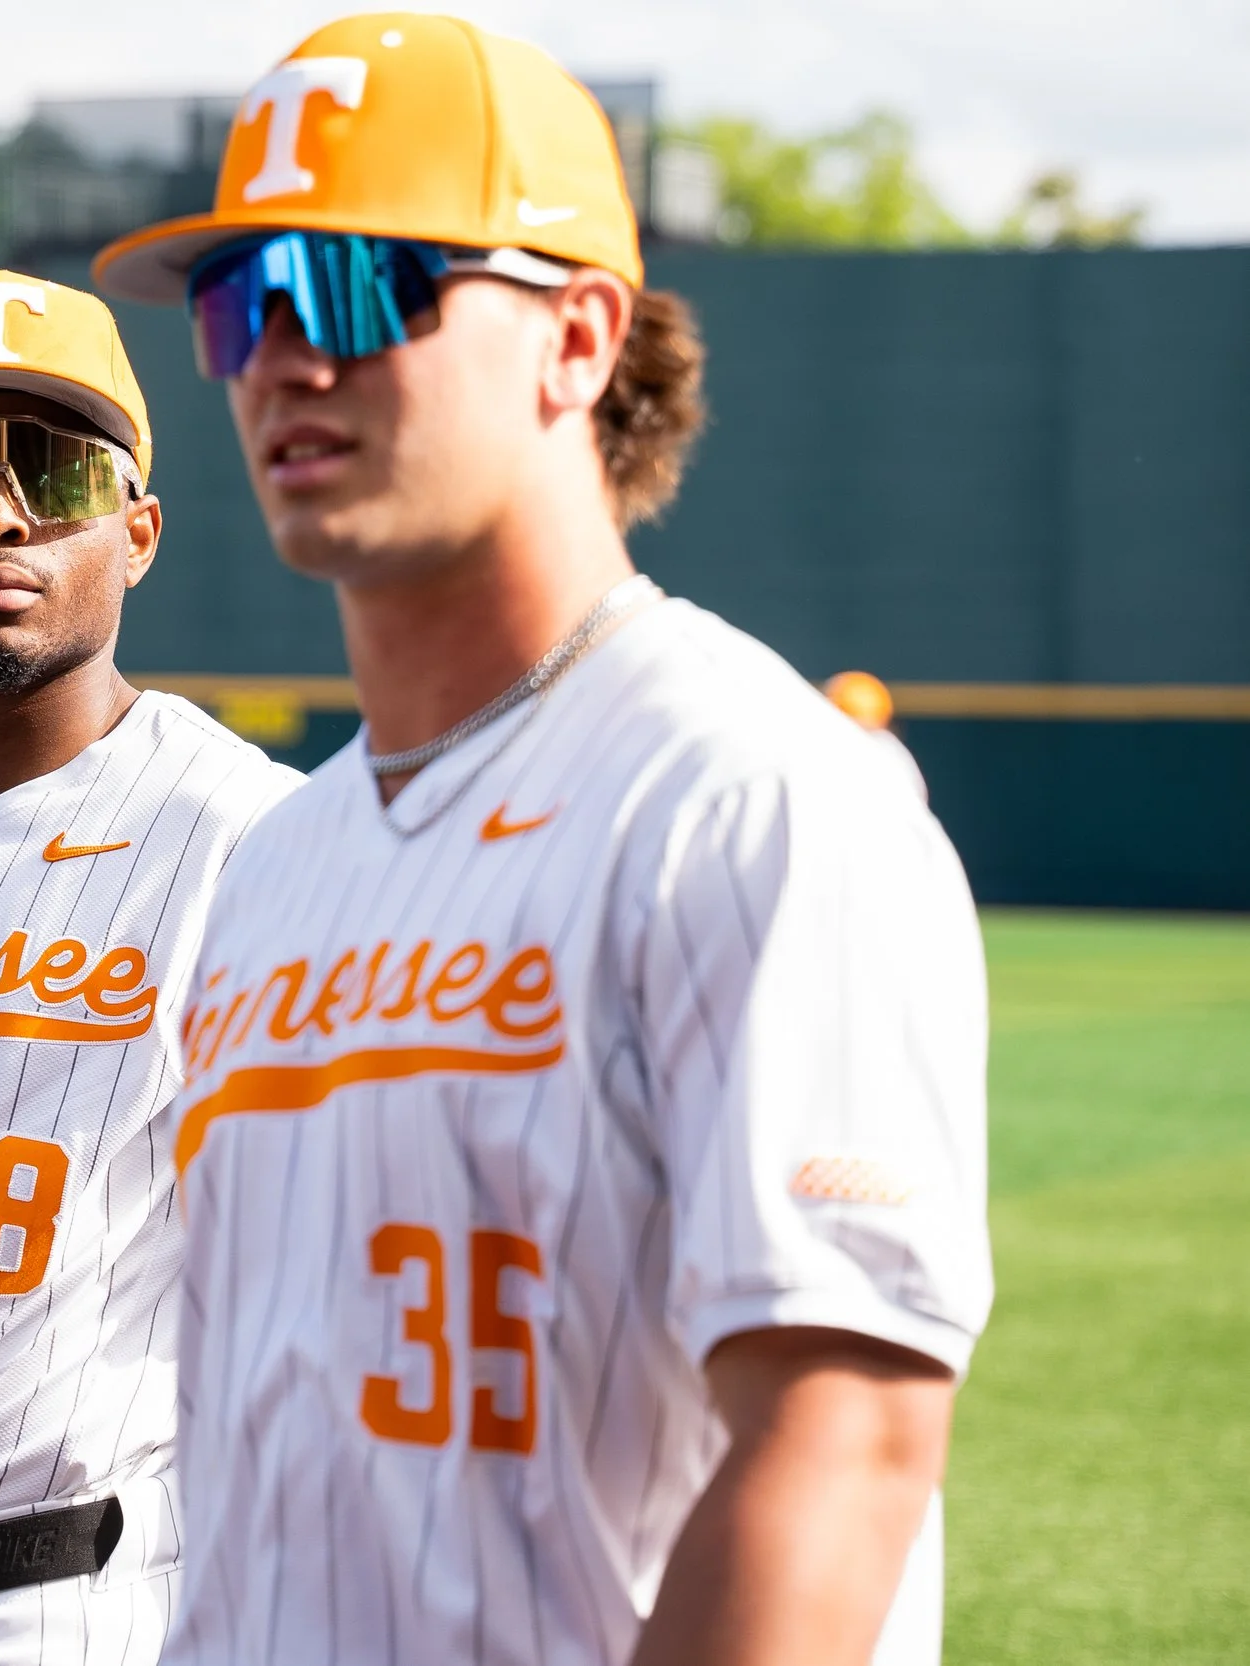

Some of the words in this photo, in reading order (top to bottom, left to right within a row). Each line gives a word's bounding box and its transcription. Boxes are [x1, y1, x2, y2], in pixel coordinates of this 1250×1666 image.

[243, 55, 369, 203] T
[181, 937, 567, 1086] nessee
[358, 1220, 548, 1458] 35
